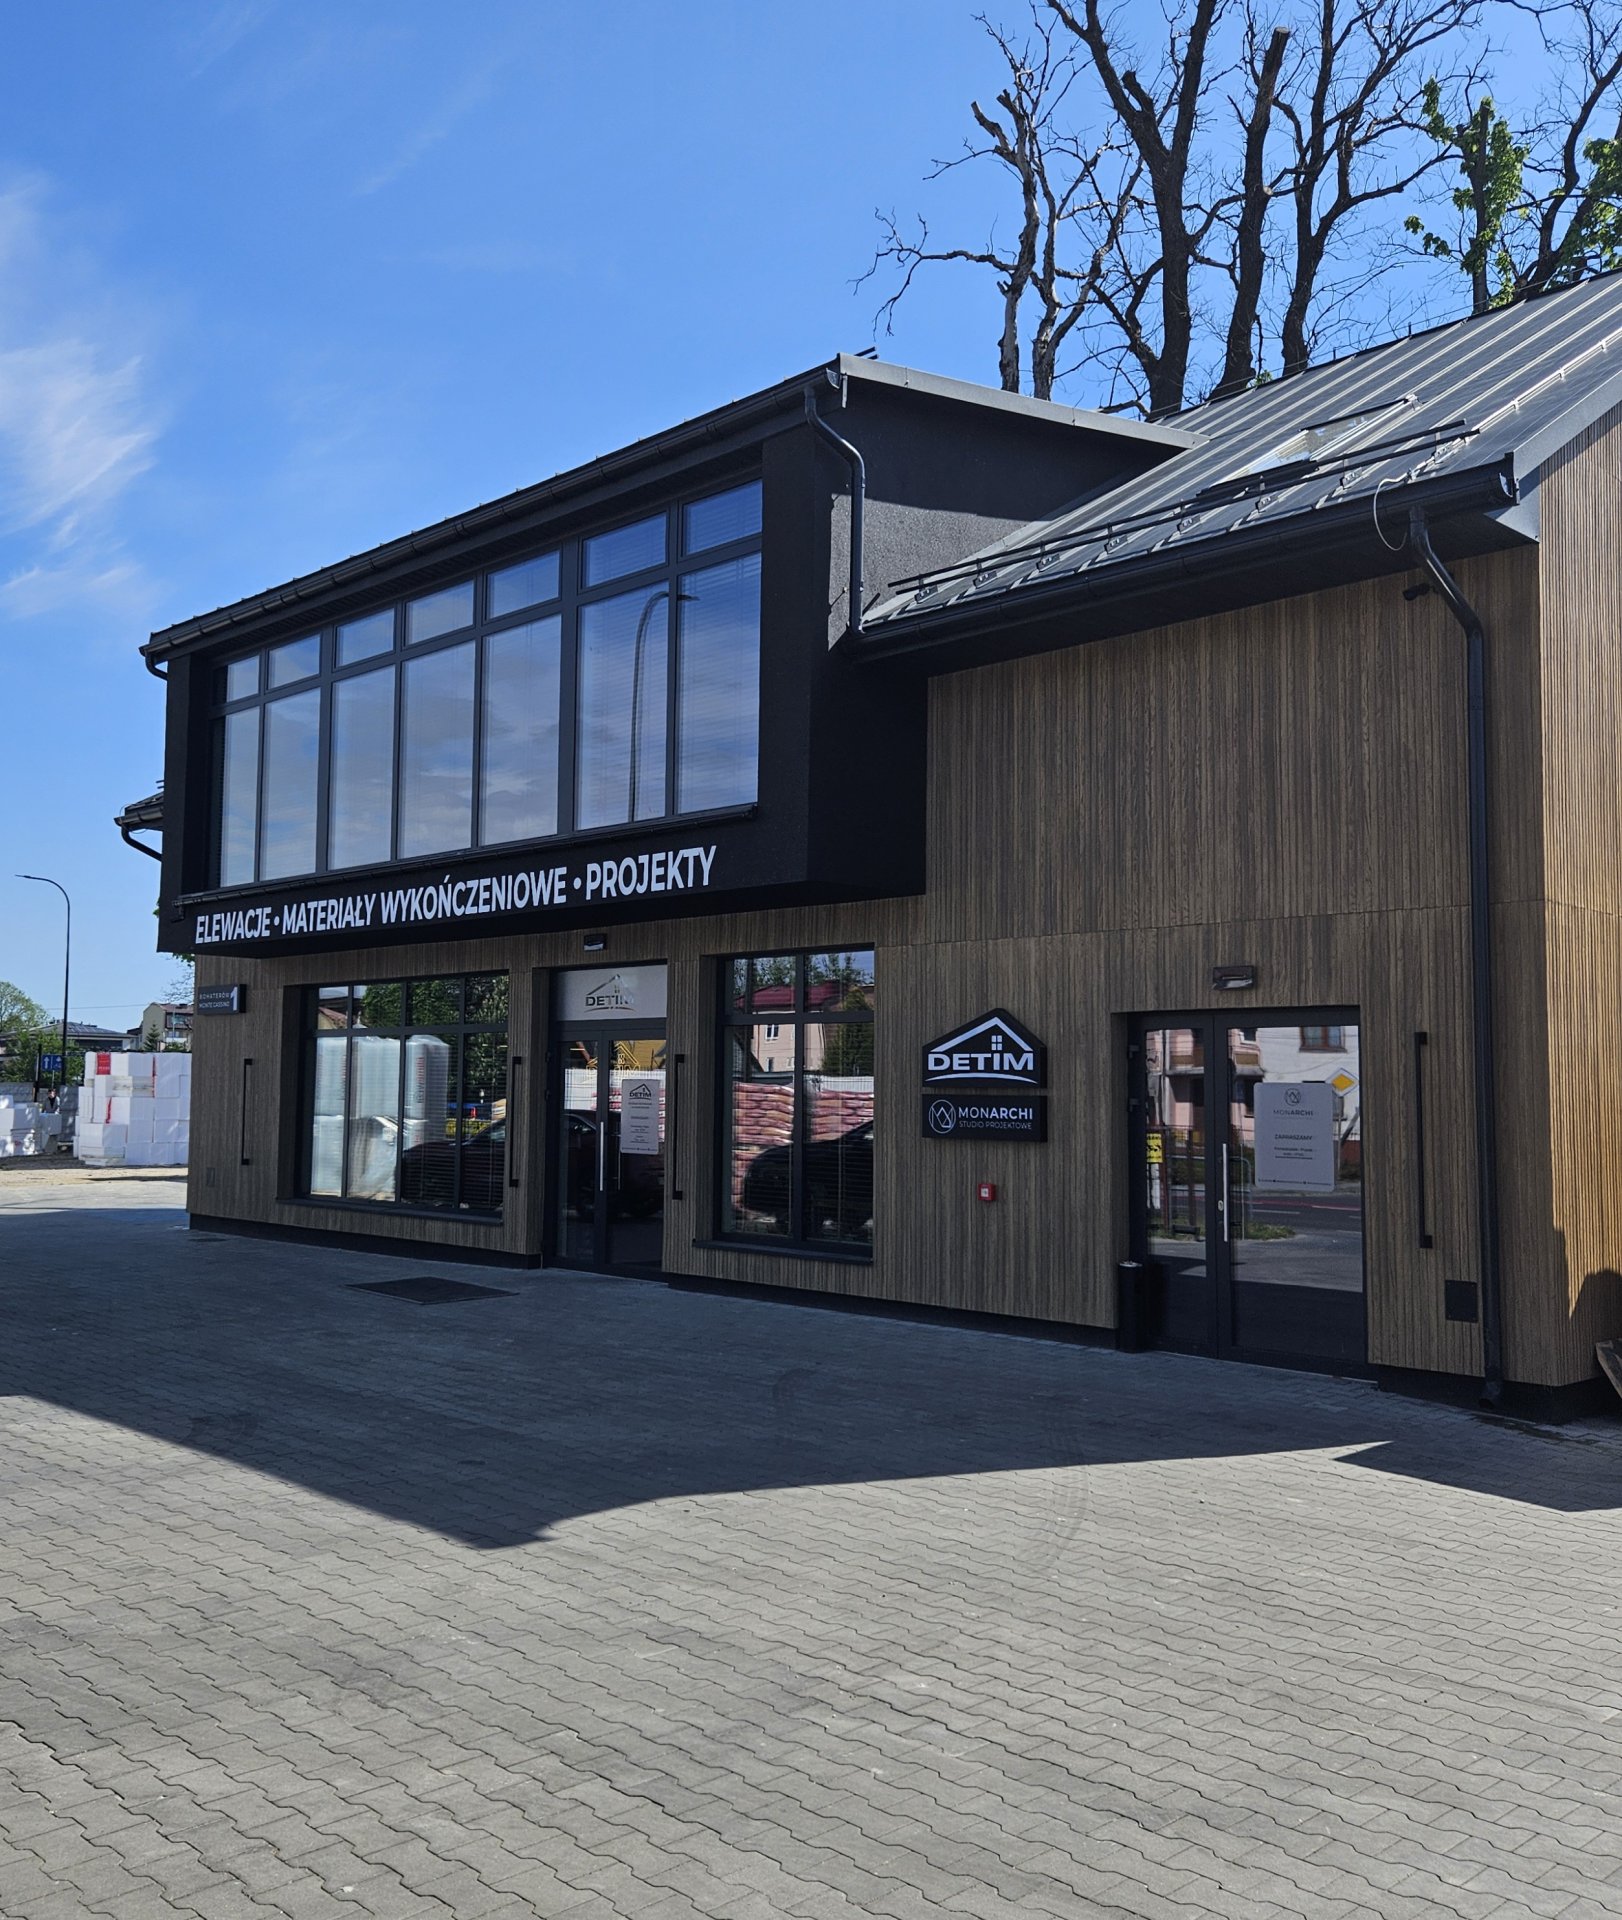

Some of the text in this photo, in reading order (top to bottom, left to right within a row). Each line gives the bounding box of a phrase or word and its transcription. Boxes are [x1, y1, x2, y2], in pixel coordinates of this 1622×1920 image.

[195, 845, 717, 944] ELEWACJE MATERIAŁY WYKOŃCZENIOWE PROJEKTY
[230, 986, 238, 1011] 1
[927, 1052, 1034, 1071] DETIM
[958, 1106, 1033, 1120] MONARCHI
[959, 1120, 1032, 1130] STUDIO PROJEKTOWE
